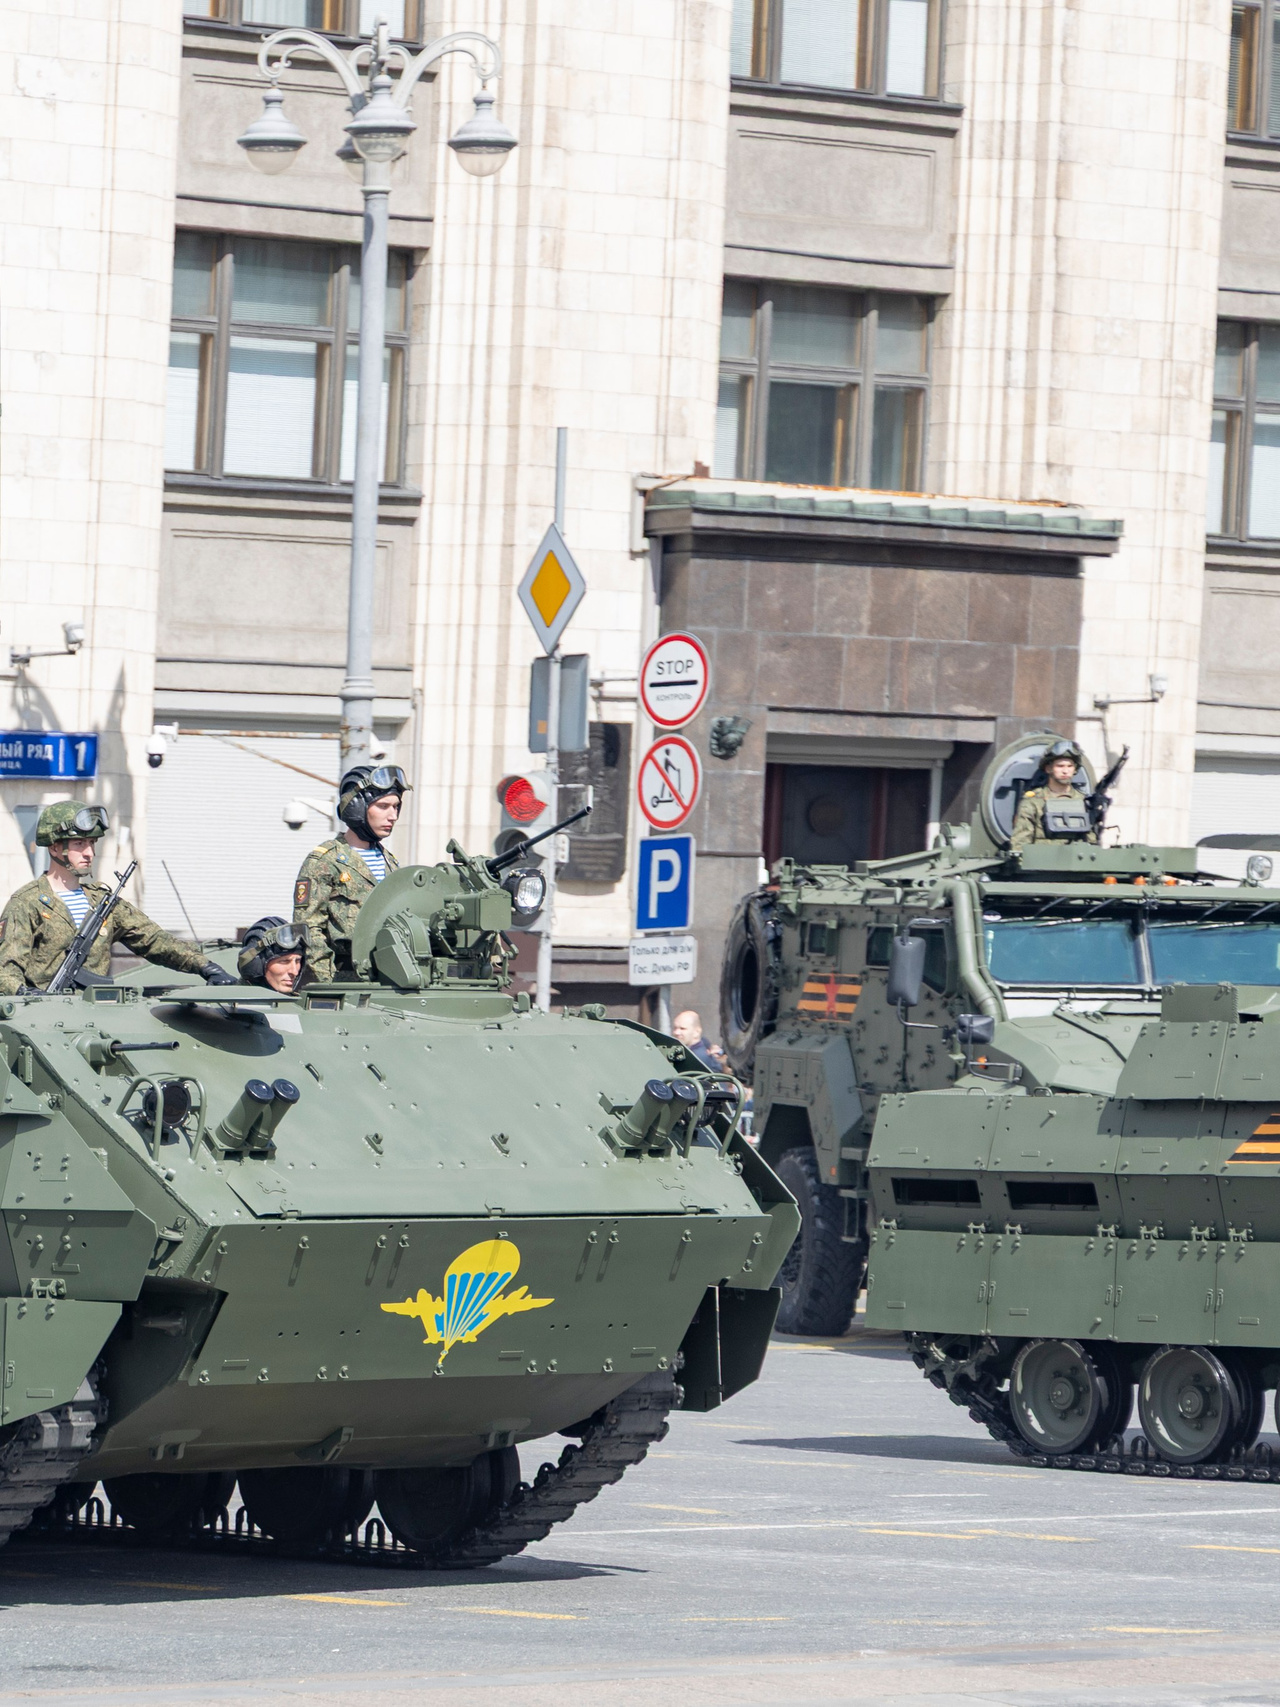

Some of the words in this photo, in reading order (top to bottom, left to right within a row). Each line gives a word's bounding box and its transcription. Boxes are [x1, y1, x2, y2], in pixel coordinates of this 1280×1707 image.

[656, 659, 694, 675] STOP
[27, 743, 54, 761] РЯД
[75, 741, 87, 771] 1
[648, 848, 682, 919] P
[631, 945, 660, 956] Только
[677, 961, 690, 971] РФ
